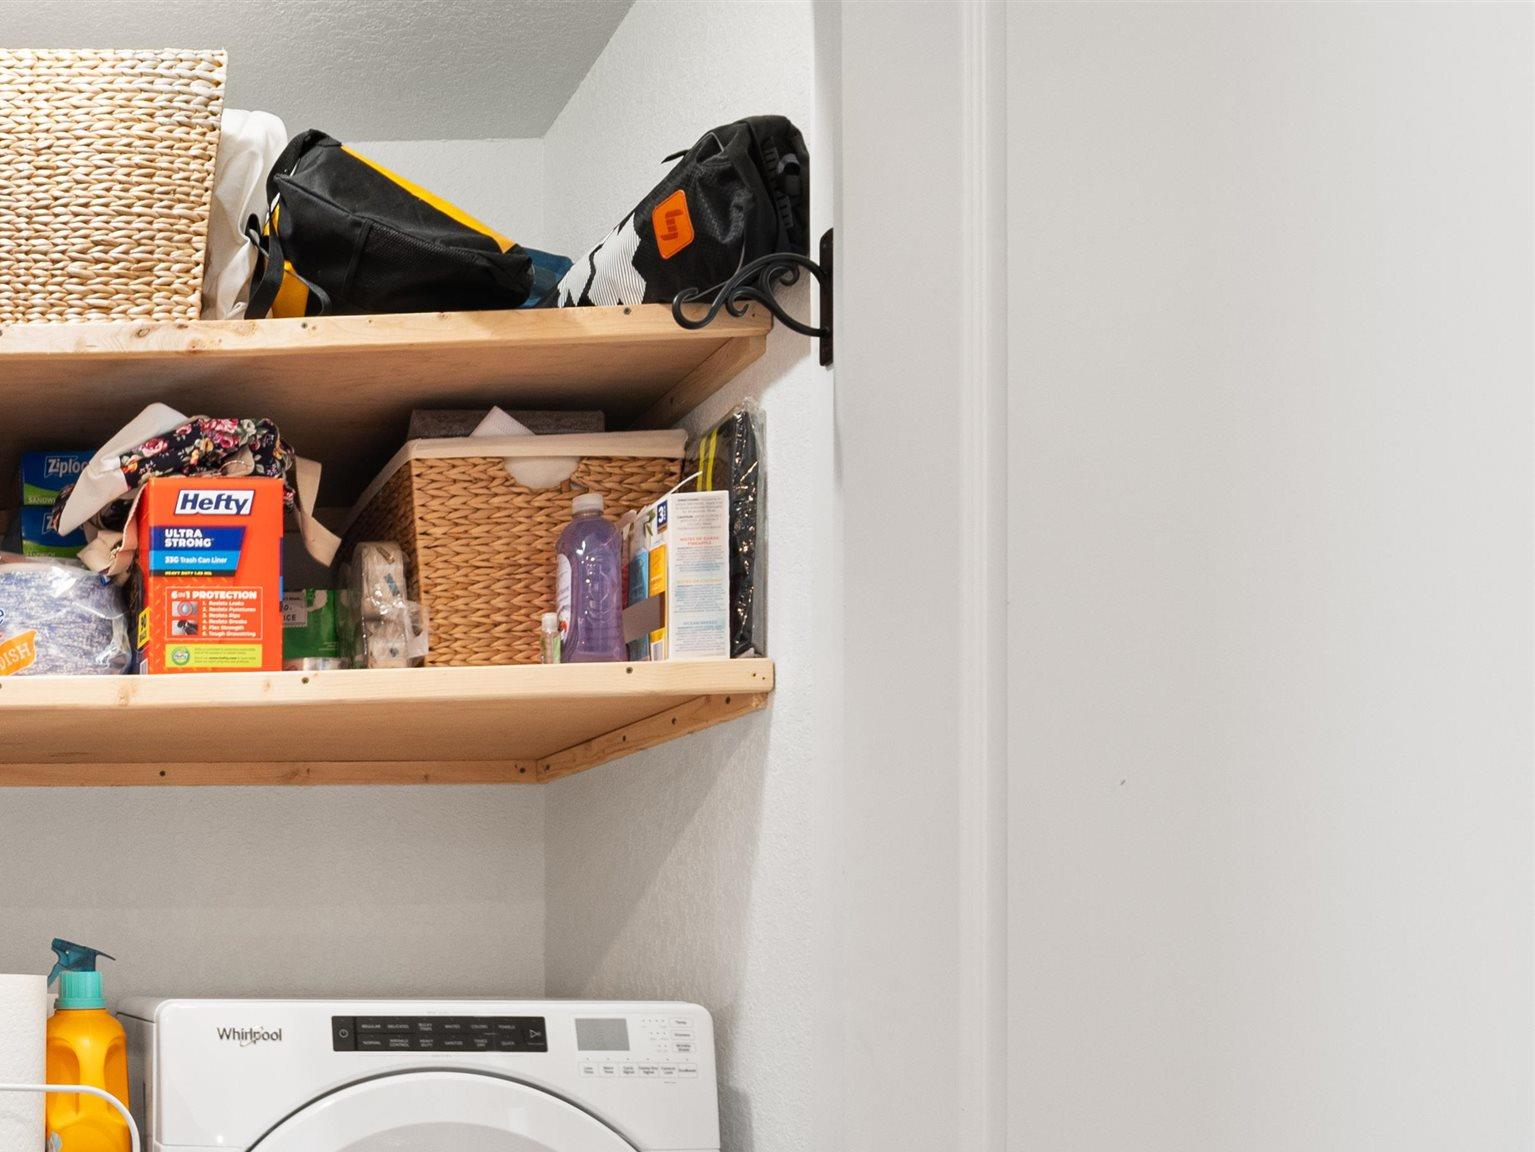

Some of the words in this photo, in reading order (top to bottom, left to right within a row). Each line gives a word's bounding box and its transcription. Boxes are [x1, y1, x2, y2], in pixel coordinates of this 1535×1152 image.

[180, 493, 249, 514] Hefty
[164, 529, 203, 538] ULTRA
[164, 538, 212, 548] STRONG
[180, 556, 197, 564] Trash
[198, 556, 211, 564] Can
[211, 556, 228, 564] Liner
[192, 591, 257, 599] PROTECTION
[216, 1027, 282, 1047] Whirlpool
